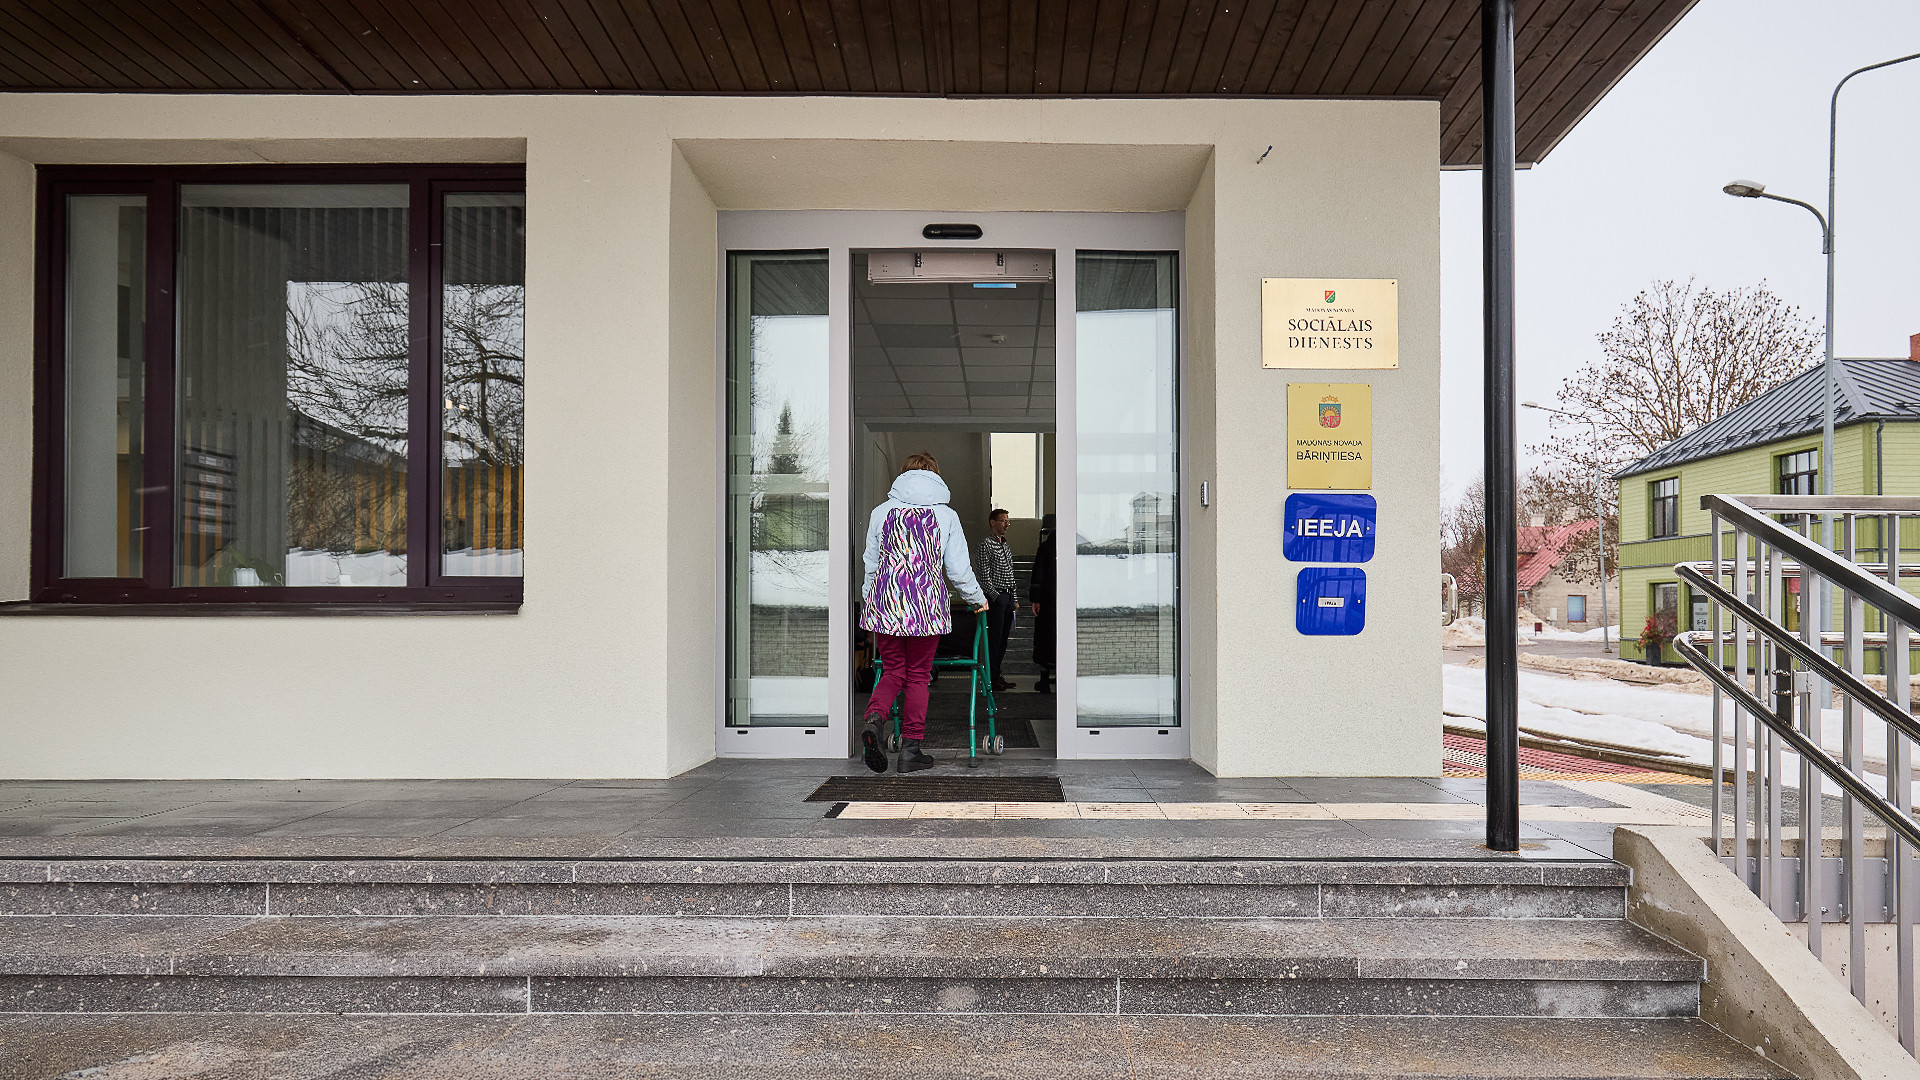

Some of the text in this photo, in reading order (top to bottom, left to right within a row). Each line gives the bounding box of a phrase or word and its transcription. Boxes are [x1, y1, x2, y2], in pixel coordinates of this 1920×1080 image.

[1288, 316, 1373, 332] SOCIĀLAIS
[1288, 336, 1373, 349] DIENESTS
[1296, 450, 1363, 463] BĀRIŅTIESA
[1297, 518, 1363, 537] IEEJA
